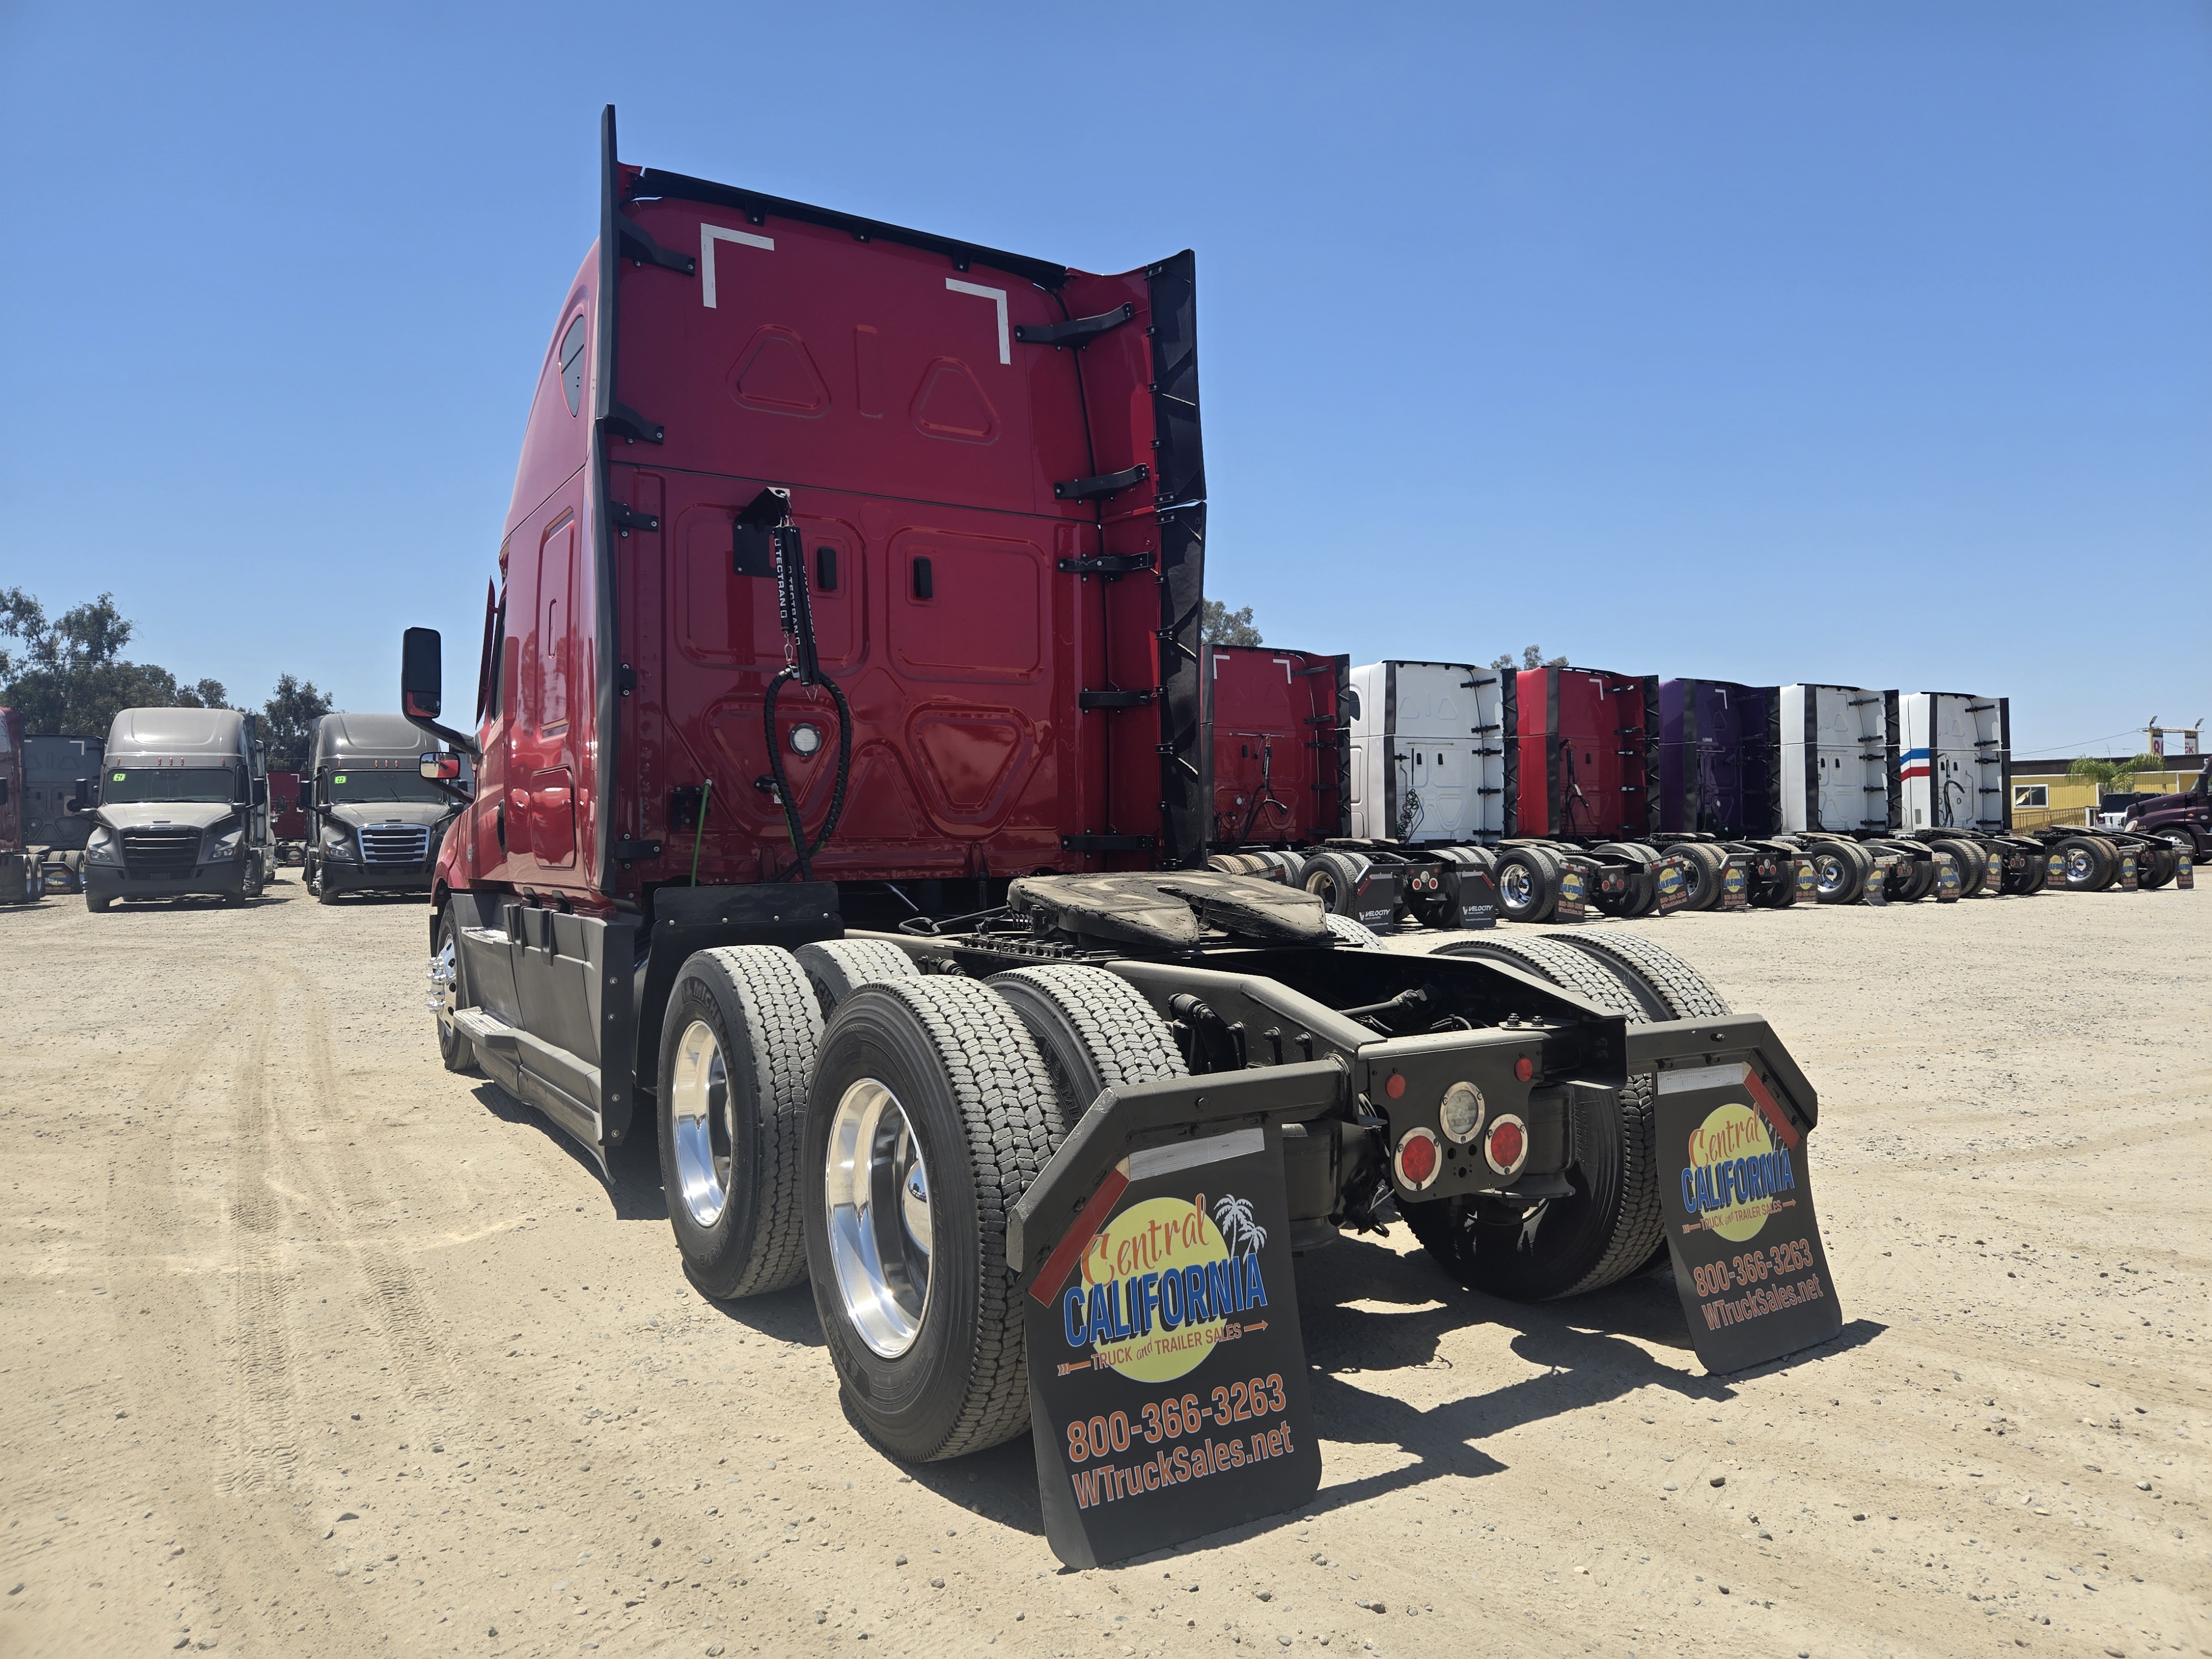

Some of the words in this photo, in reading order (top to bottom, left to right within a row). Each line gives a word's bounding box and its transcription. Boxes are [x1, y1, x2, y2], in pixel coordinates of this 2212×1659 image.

[776, 549, 786, 607] TECTRAN
[788, 576, 799, 634] TECTRAN
[1365, 909, 1391, 917] VELOCITY
[693, 980, 734, 1069] MICHELIN
[1688, 1102, 1762, 1169] Central
[1681, 1148, 1795, 1213] CALIFORNIA
[1082, 1193, 1210, 1287] Central
[1700, 1213, 1723, 1231] TRUCK
[1725, 1209, 1735, 1225] and
[1734, 1206, 1761, 1222] TRAILER
[1761, 1199, 1782, 1216] SALES
[1693, 1238, 1814, 1297] 800-366-3263
[1063, 1253, 1269, 1348] CALIFORNIA
[1701, 1272, 1824, 1331] WTruckSales.net
[1091, 1347, 1133, 1371] TRUCK
[1136, 1337, 1154, 1361] and
[1154, 1331, 1203, 1355] TRAILER
[1206, 1322, 1242, 1348] SALES
[1067, 1373, 1287, 1464] 800-366-3263
[1072, 1420, 1294, 1510] WTruckSales.net
